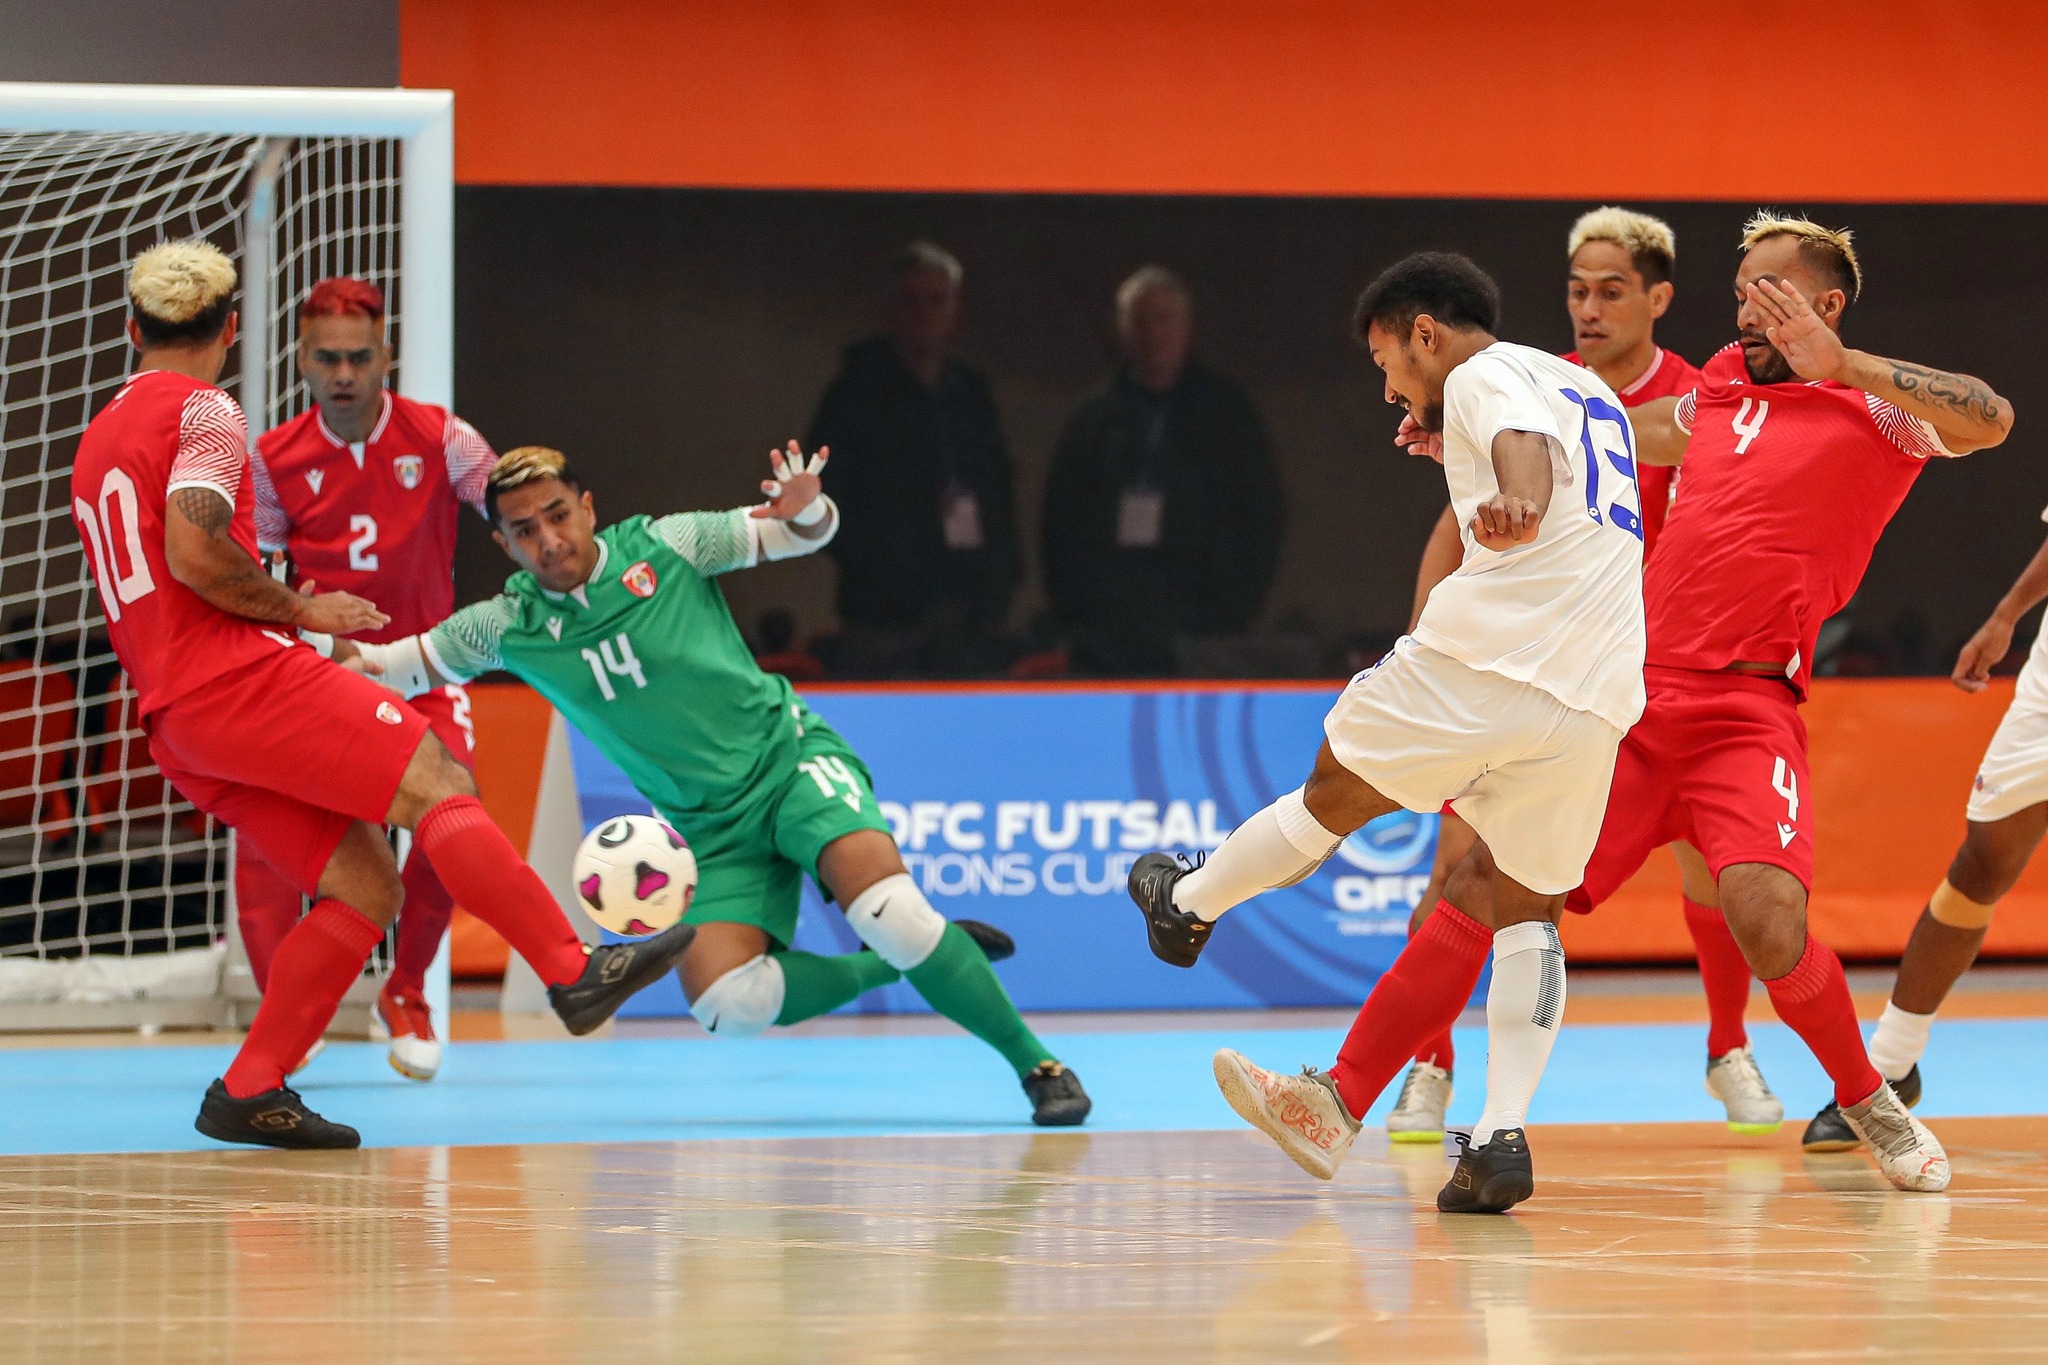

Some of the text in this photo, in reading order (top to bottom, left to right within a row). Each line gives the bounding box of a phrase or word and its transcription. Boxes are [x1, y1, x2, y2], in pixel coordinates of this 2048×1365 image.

[1731, 396, 1769, 455] 4
[1558, 387, 1643, 542] 13
[74, 466, 156, 624] 10
[348, 514, 379, 572] 2
[581, 632, 648, 701] 14
[797, 755, 863, 799] 14
[1771, 755, 1799, 823] 4
[996, 800, 1231, 851] FUTSAL
[902, 852, 1038, 897] TIONS
